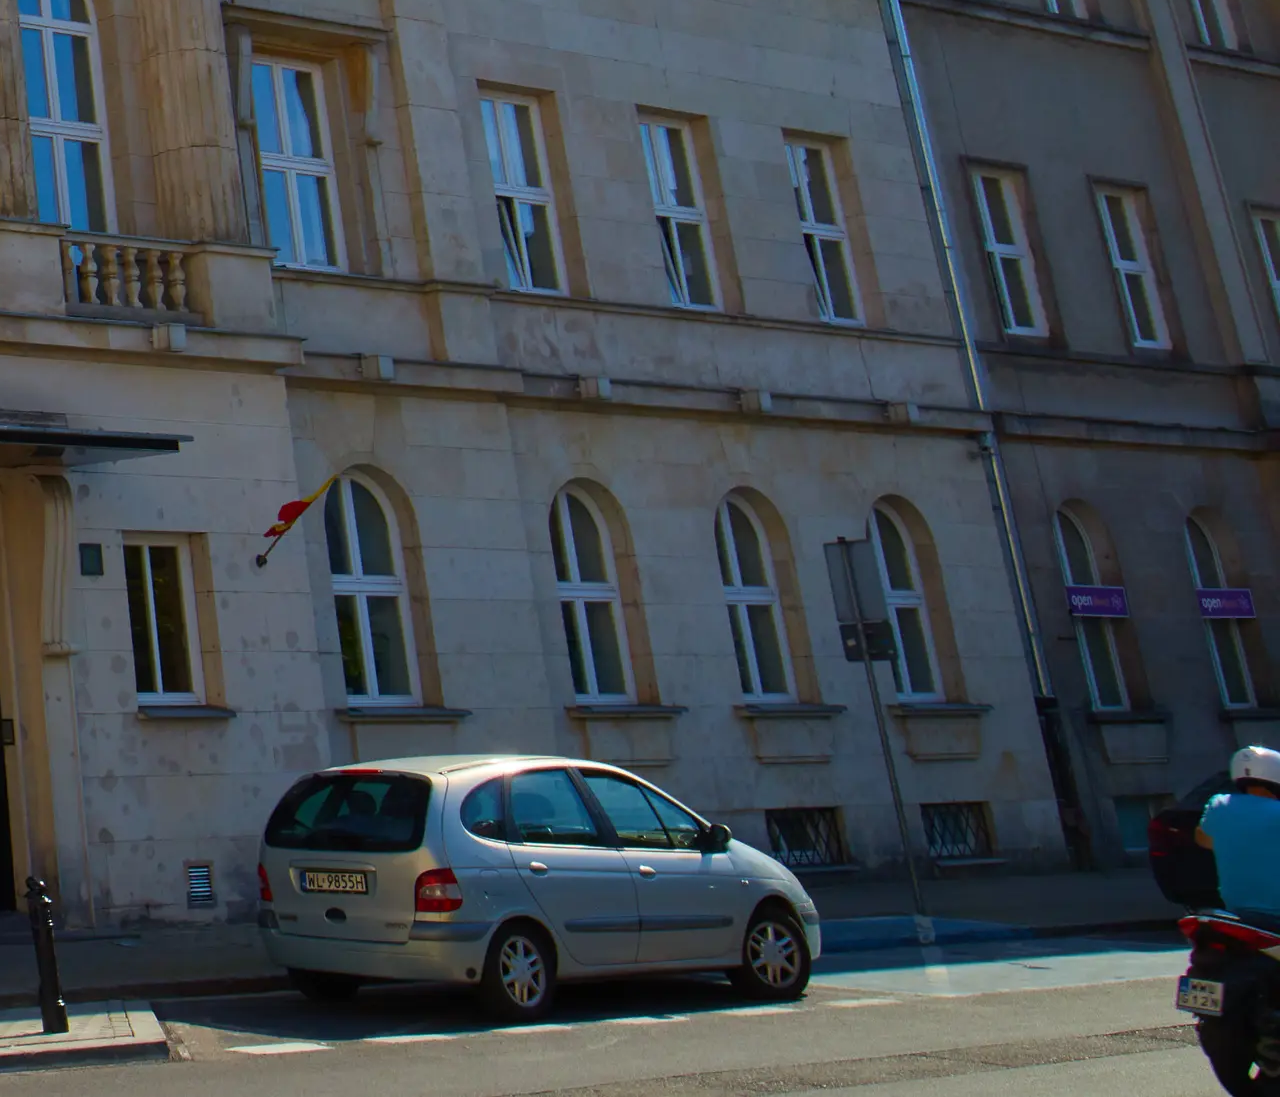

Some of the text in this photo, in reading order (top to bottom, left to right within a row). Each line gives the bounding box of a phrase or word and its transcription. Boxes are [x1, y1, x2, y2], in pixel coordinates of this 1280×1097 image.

[1071, 594, 1093, 611] open
[1201, 597, 1223, 613] open
[307, 874, 364, 890] WL 9855H
